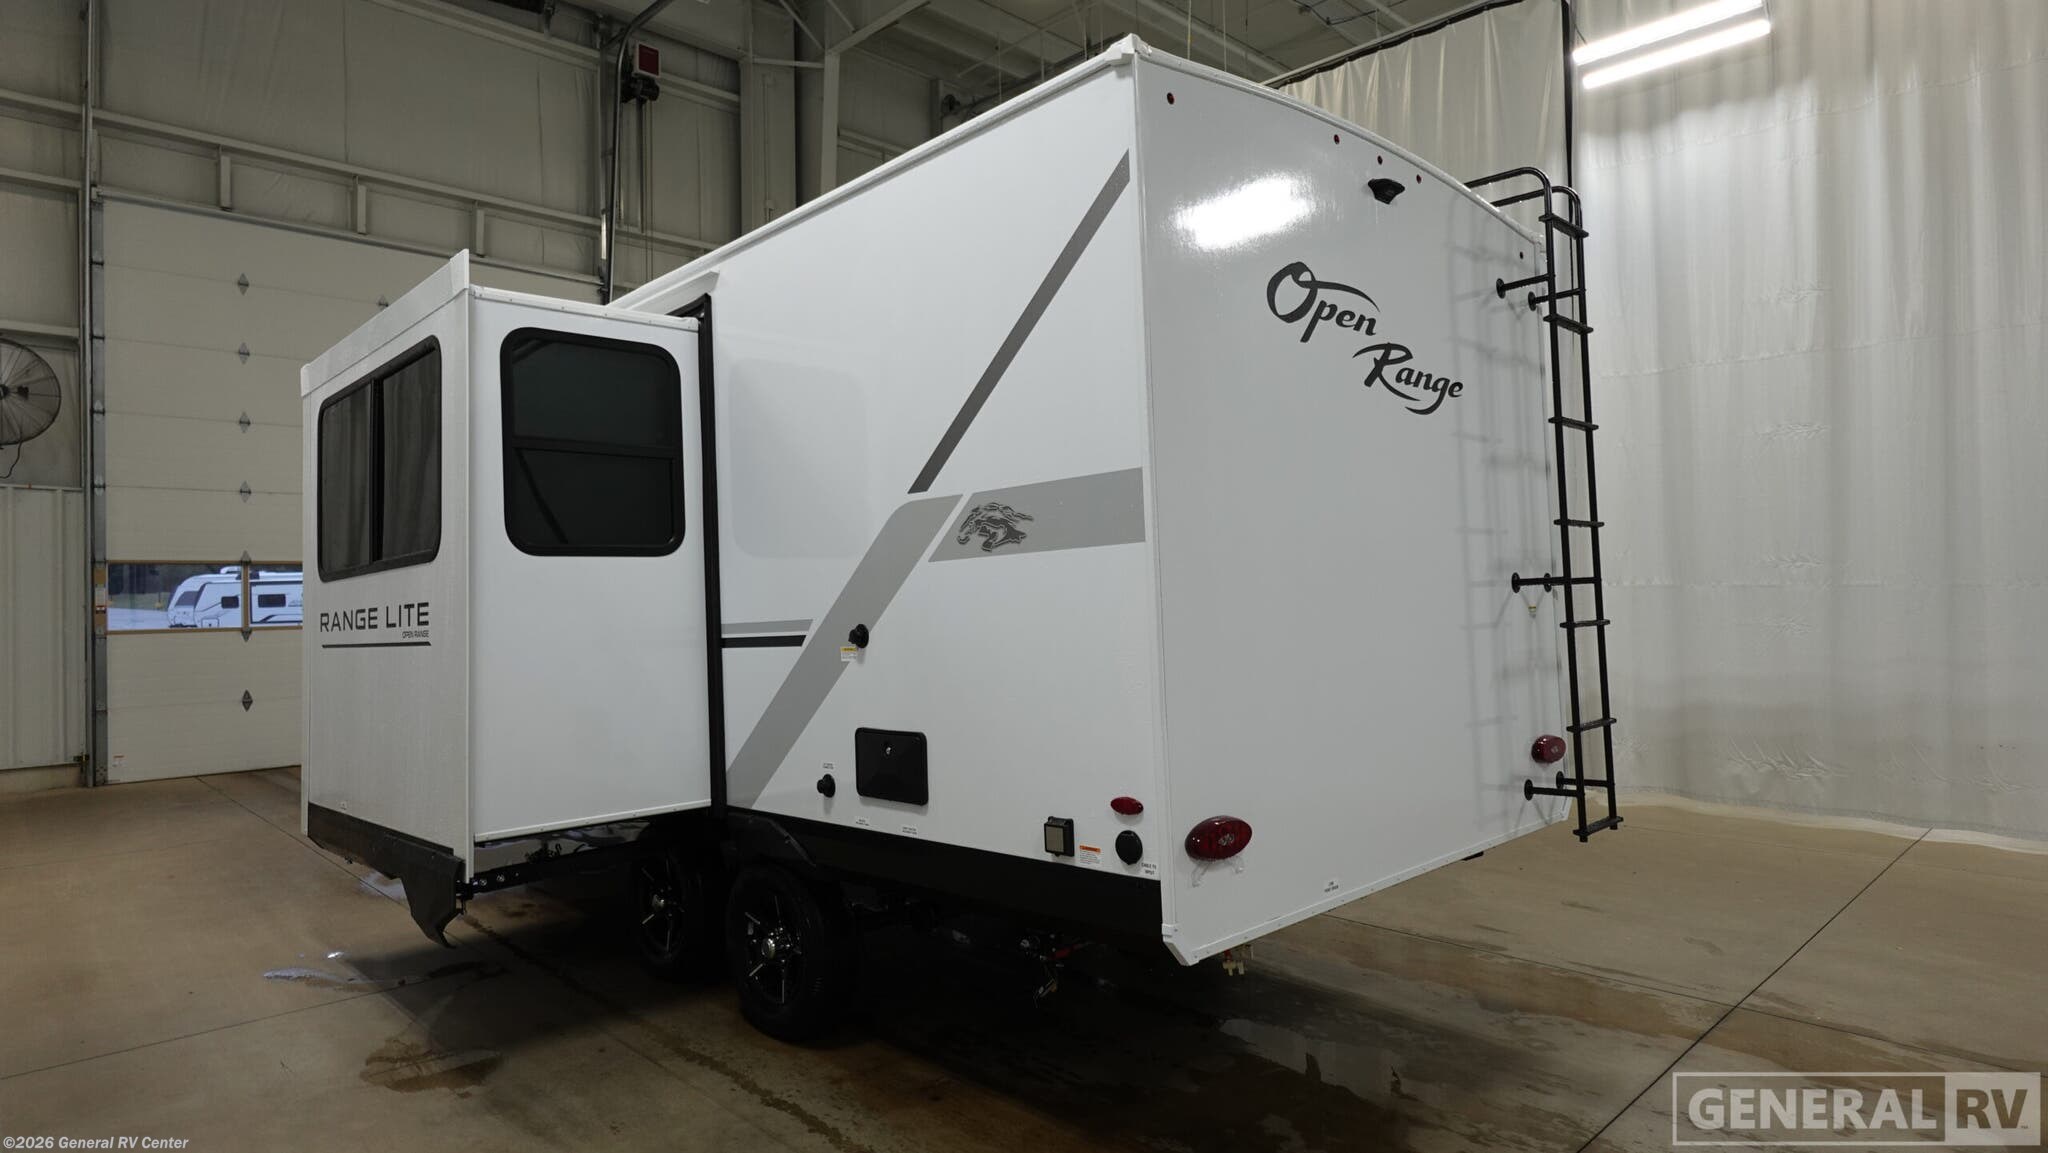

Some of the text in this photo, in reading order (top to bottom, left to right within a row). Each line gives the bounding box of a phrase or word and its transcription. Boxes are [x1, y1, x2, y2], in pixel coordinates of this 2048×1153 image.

[1267, 261, 1380, 343] Open
[1352, 342, 1464, 415] Range
[320, 602, 429, 632] RANGE LITE
[402, 630, 429, 638] OPEN RANGE
